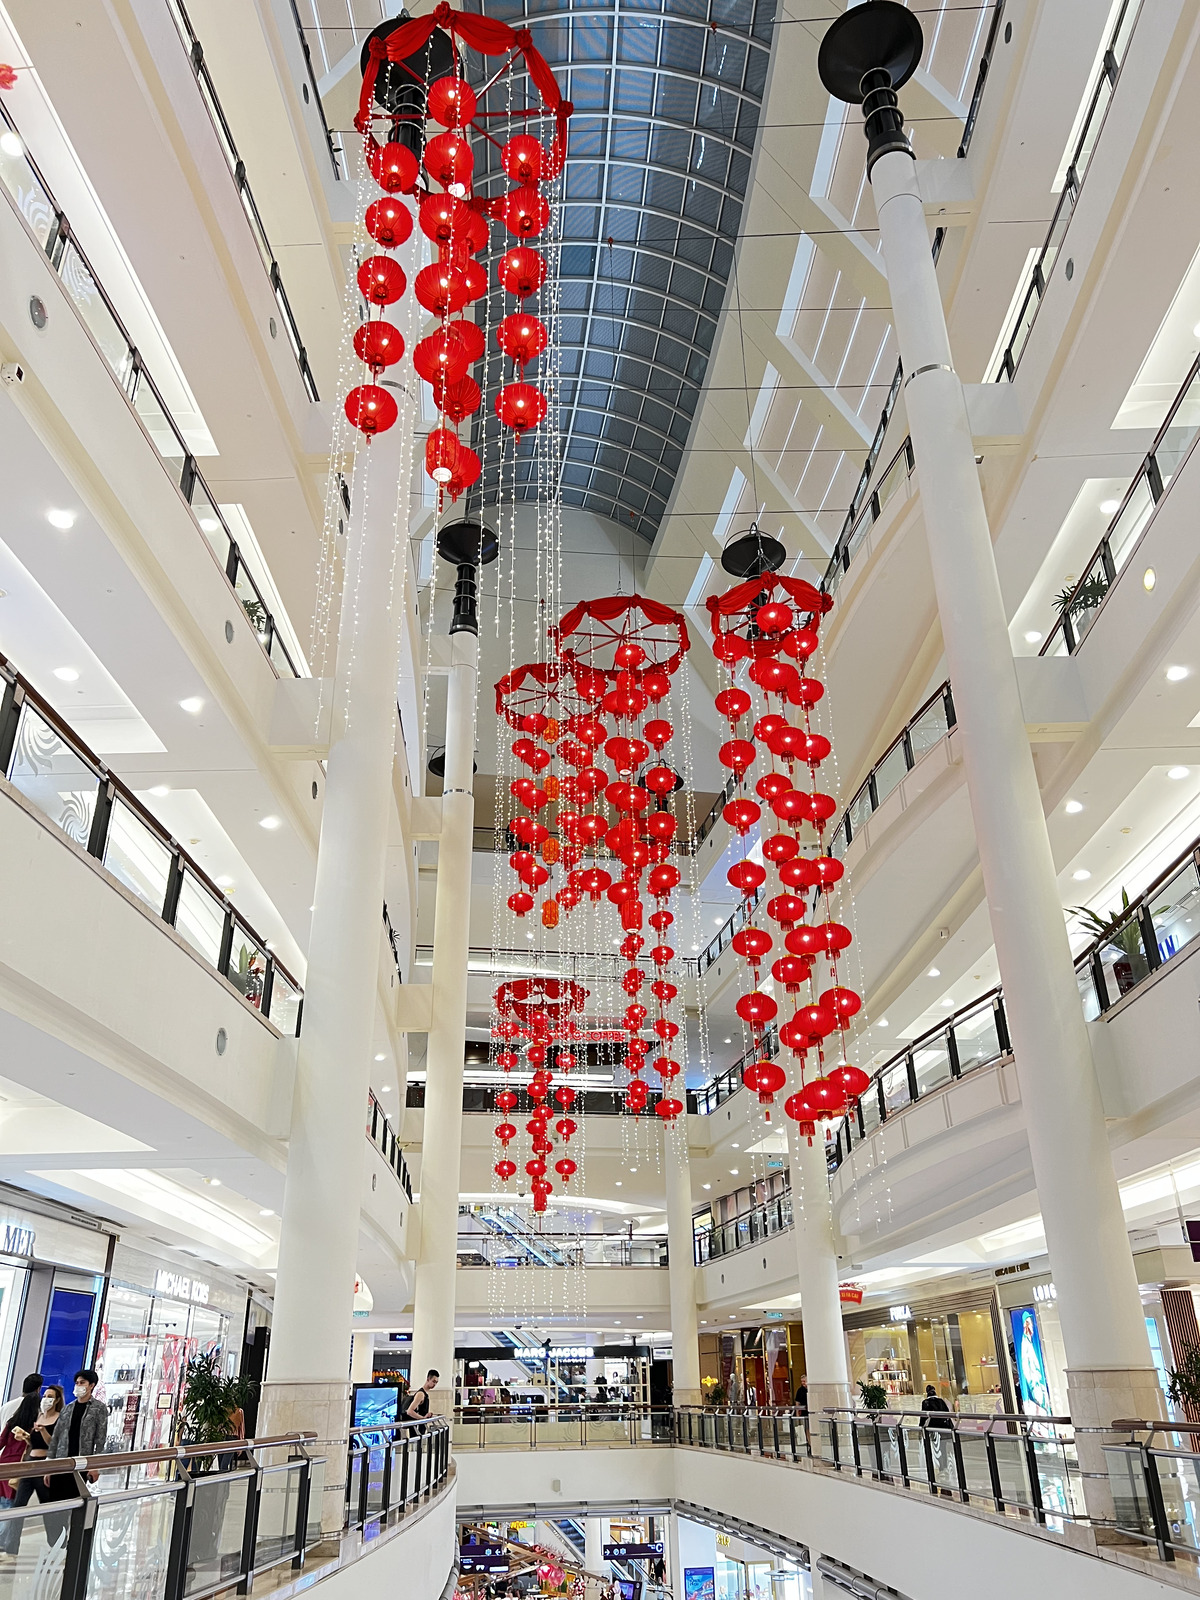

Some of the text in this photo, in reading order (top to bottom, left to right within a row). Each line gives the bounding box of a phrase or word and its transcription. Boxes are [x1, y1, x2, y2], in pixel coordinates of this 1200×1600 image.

[584, 1030, 626, 1041] COFFEE
[3, 1225, 36, 1257] MER
[155, 1269, 210, 1304] MICHAEL KORS
[889, 1304, 912, 1321] FURLA
[514, 1346, 594, 1358] MARC JACOBS
[655, 1543, 663, 1553] C
